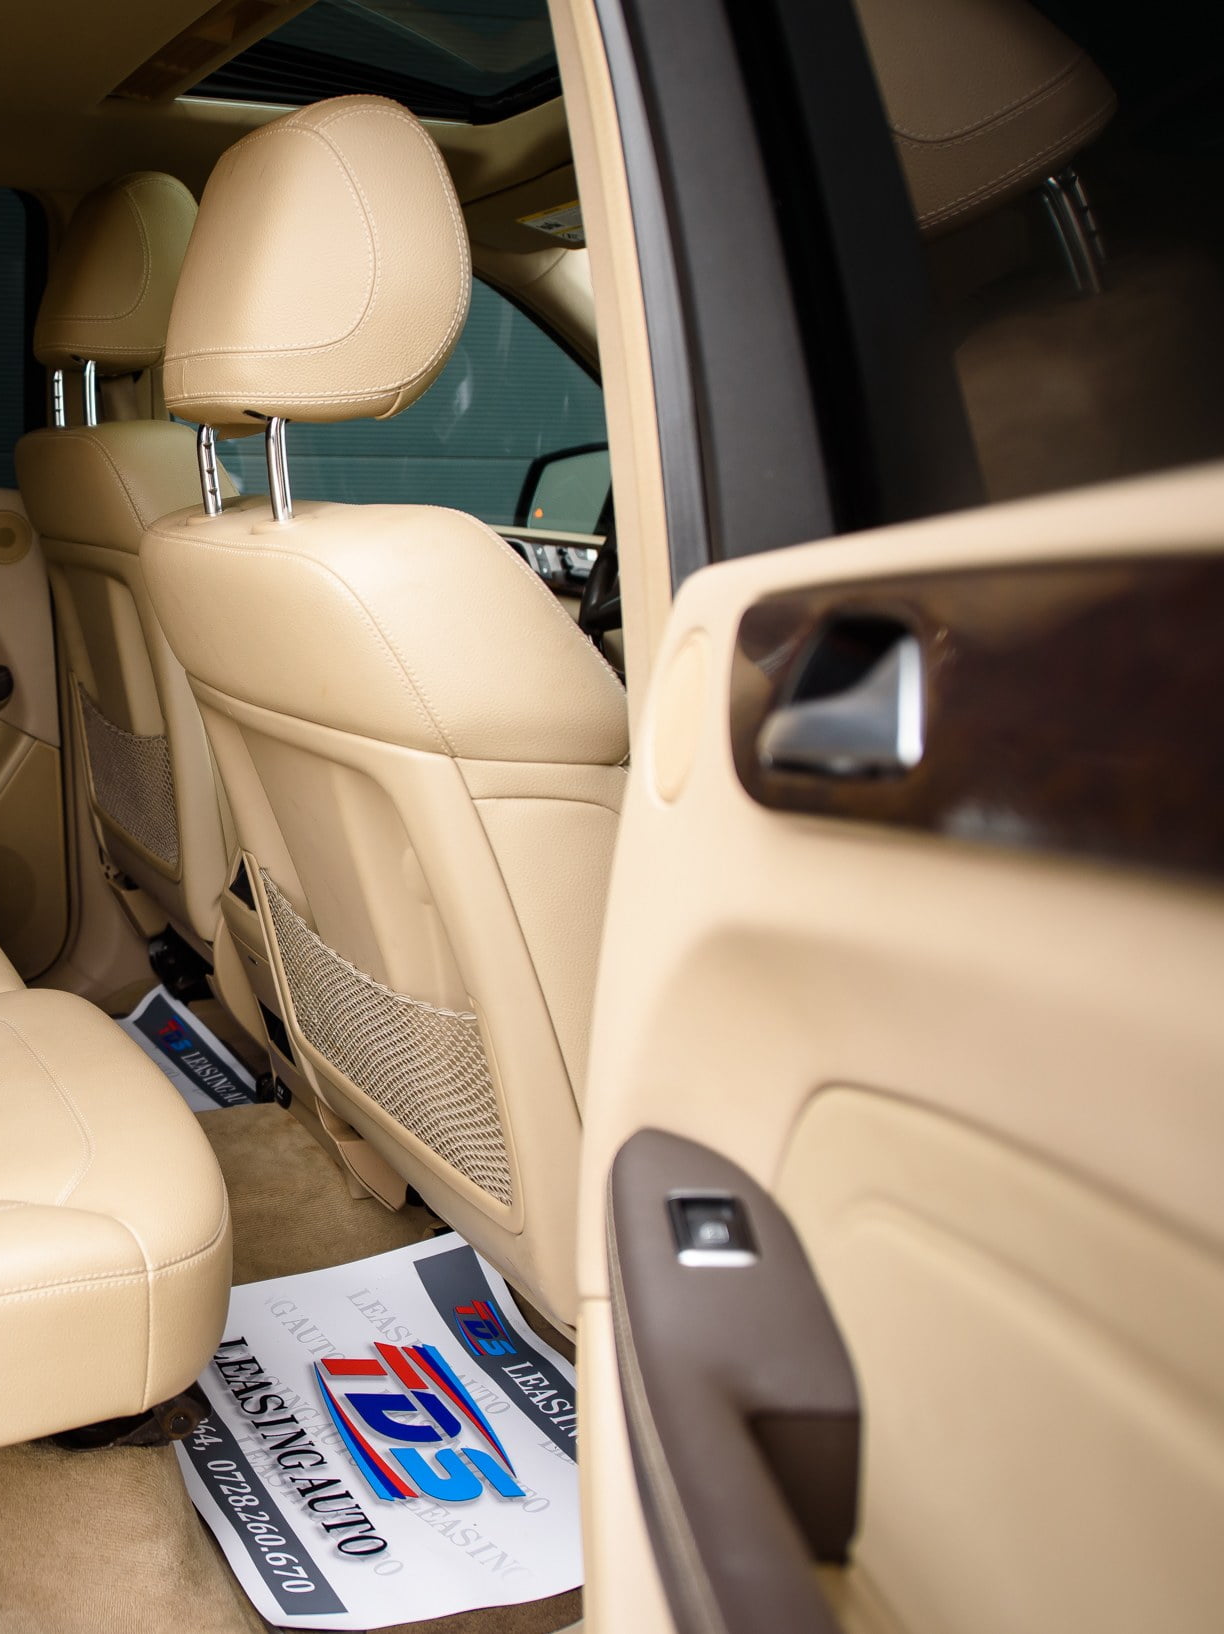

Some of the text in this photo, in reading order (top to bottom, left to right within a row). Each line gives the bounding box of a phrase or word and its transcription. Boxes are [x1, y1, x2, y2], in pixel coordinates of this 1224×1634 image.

[455, 1300, 517, 1357] TDS
[316, 1341, 527, 1502] TDS
[207, 1459, 316, 1593] 0728.260.670
